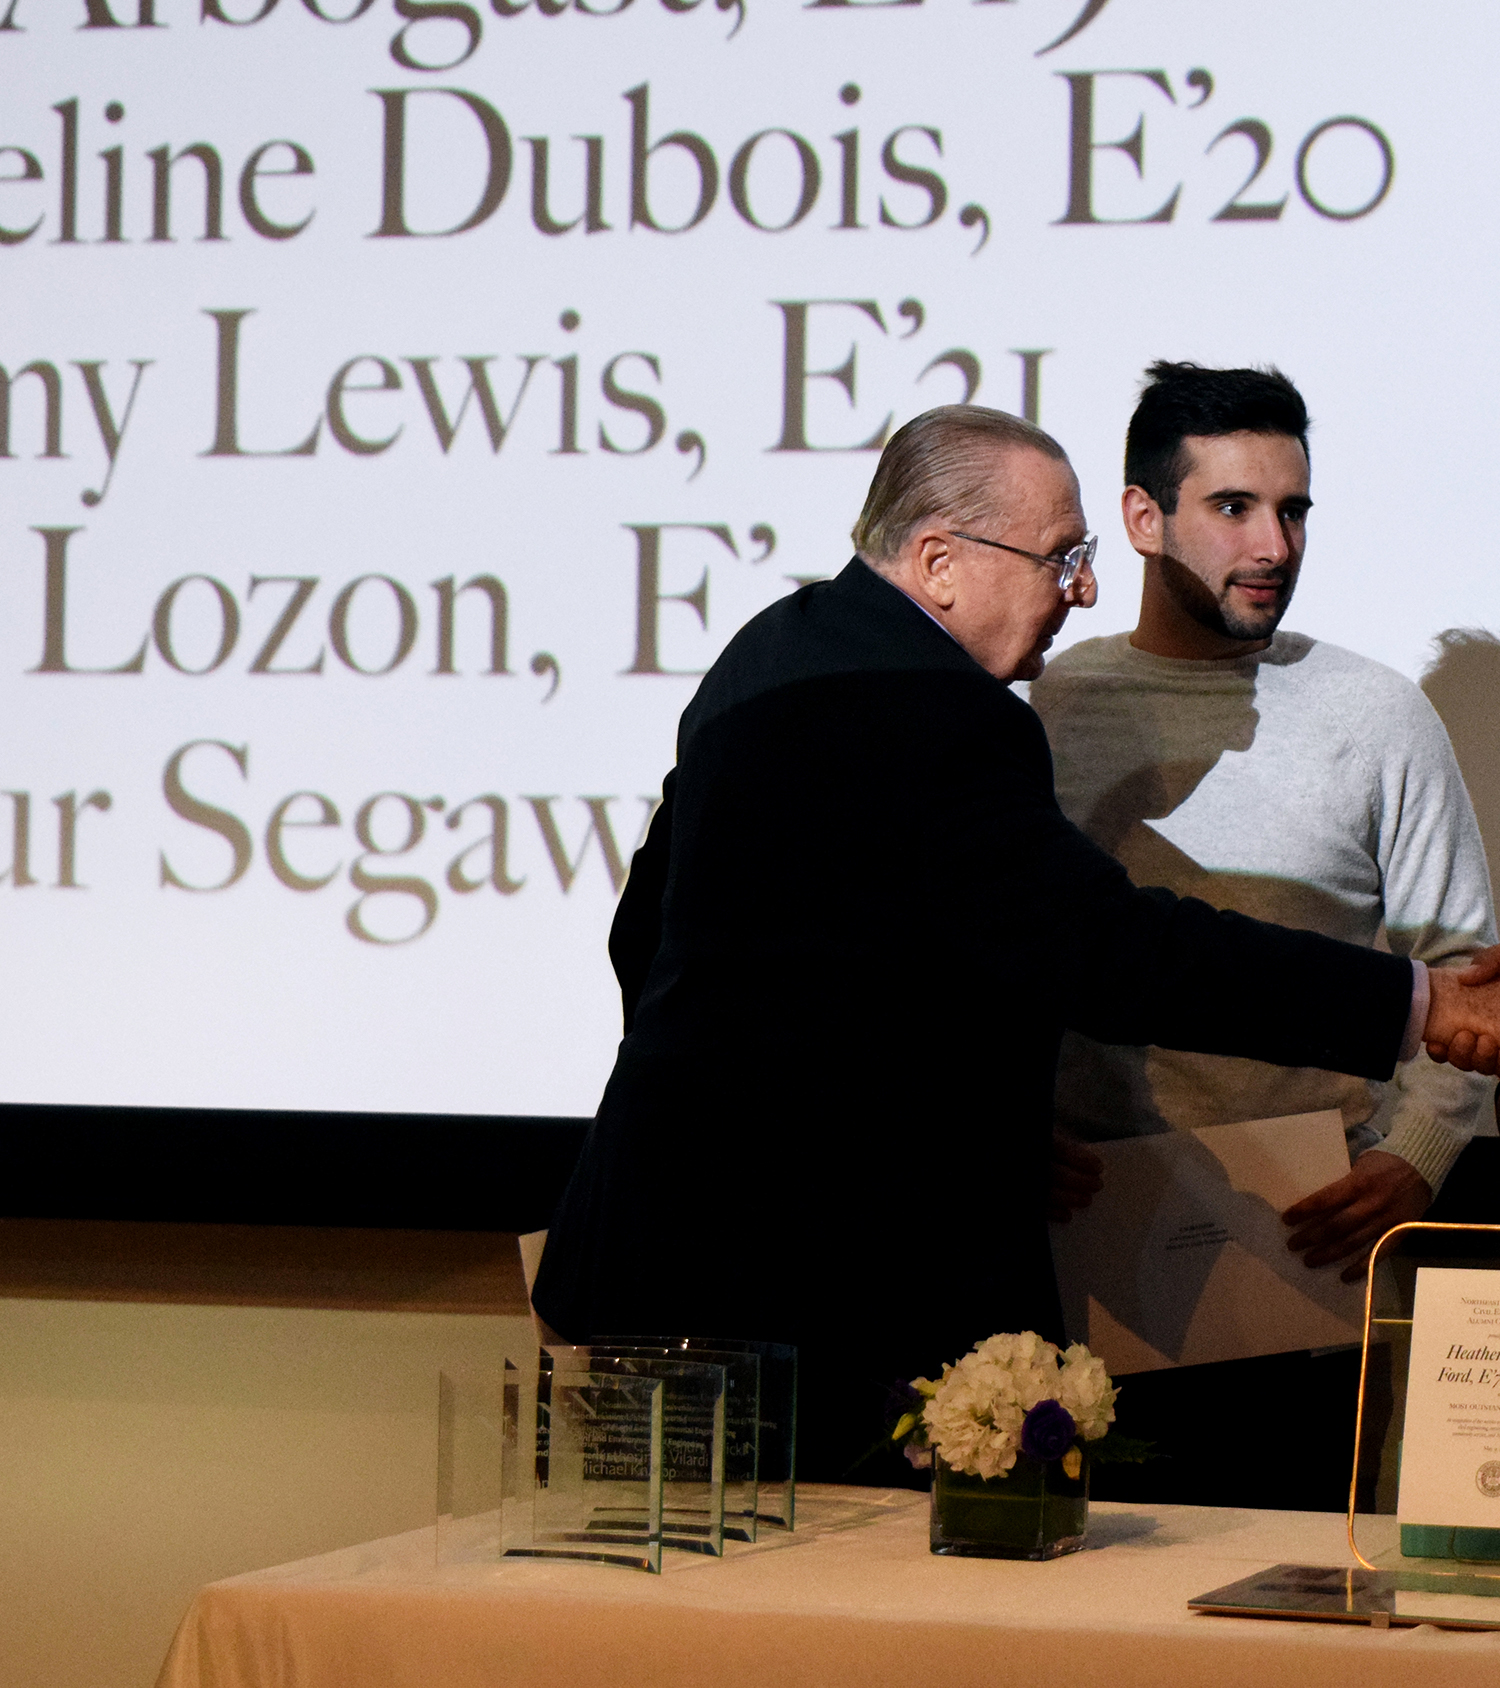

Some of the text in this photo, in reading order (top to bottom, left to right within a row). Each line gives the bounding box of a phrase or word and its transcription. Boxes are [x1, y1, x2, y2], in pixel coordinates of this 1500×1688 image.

[364, 81, 991, 257] Dubois,
[1048, 67, 1397, 227] E'20
[198, 308, 707, 482] Lewis,
[24, 520, 832, 704] Lozon, E'
[1466, 1316, 1494, 1326] ALUMNI
[1473, 1307, 1492, 1316] CIVIL
[1437, 1366, 1474, 1386] Ford,
[1449, 1402, 1467, 1411] MOST
